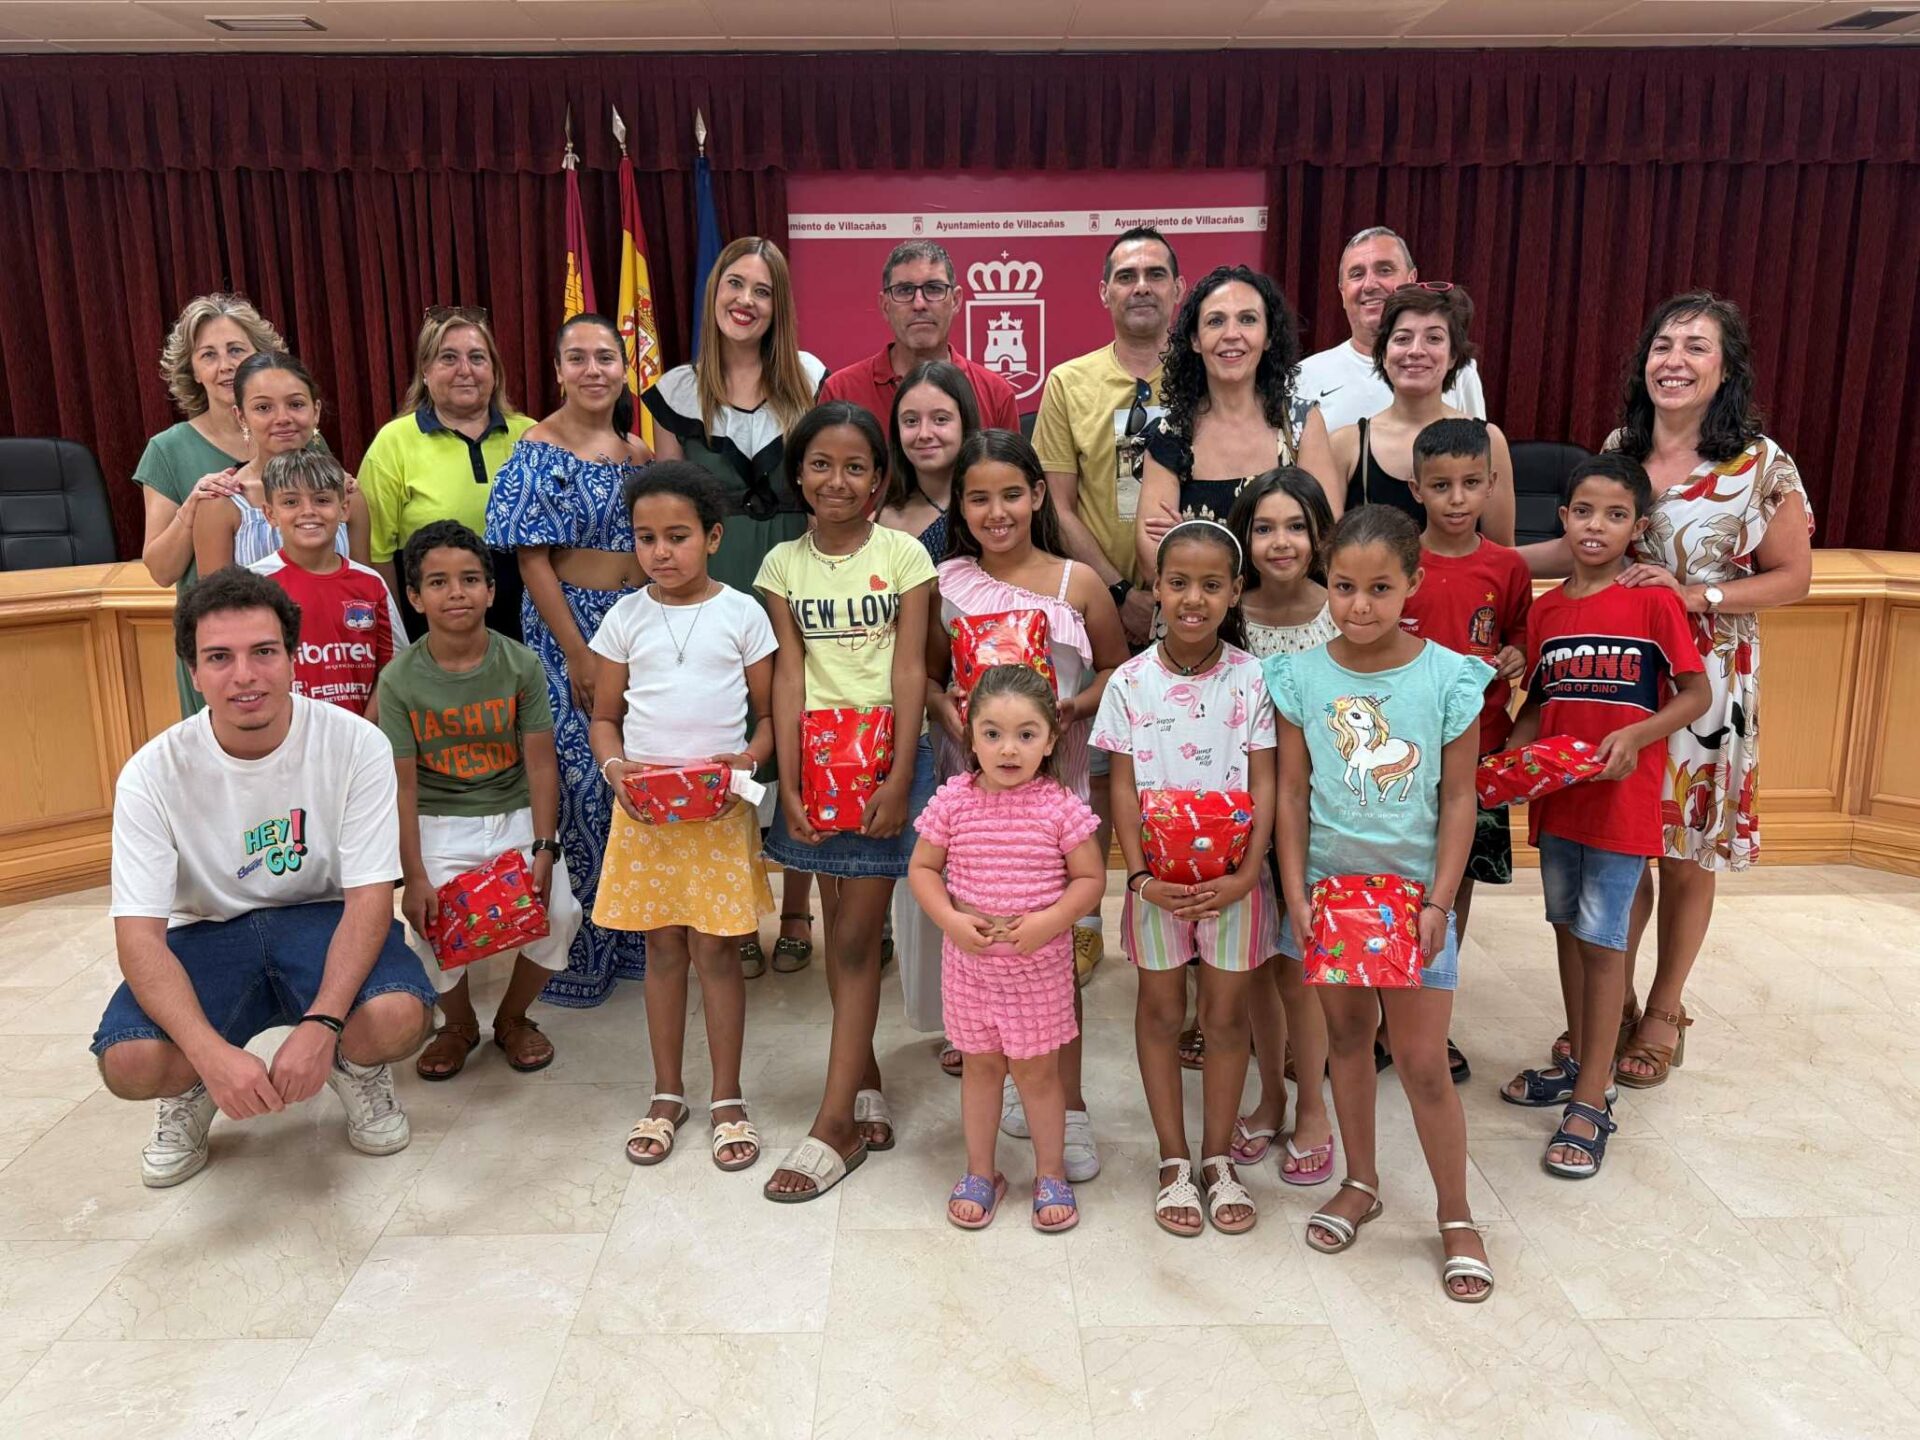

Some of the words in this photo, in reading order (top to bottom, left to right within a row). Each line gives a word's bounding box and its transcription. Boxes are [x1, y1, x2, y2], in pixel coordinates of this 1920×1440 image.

[824, 221, 836, 231] de
[838, 221, 887, 231] Villacañas
[936, 220, 1000, 232] Ayuntamiento
[1002, 219, 1014, 229] de
[1017, 219, 1065, 229] Villacañas
[1114, 215, 1179, 227] Ayuntamiento
[1181, 215, 1193, 225] de
[1195, 214, 1244, 225] Villacañas
[1574, 683, 1589, 692] OF
[1591, 683, 1618, 693] DINO
[265, 845, 302, 876] GO
